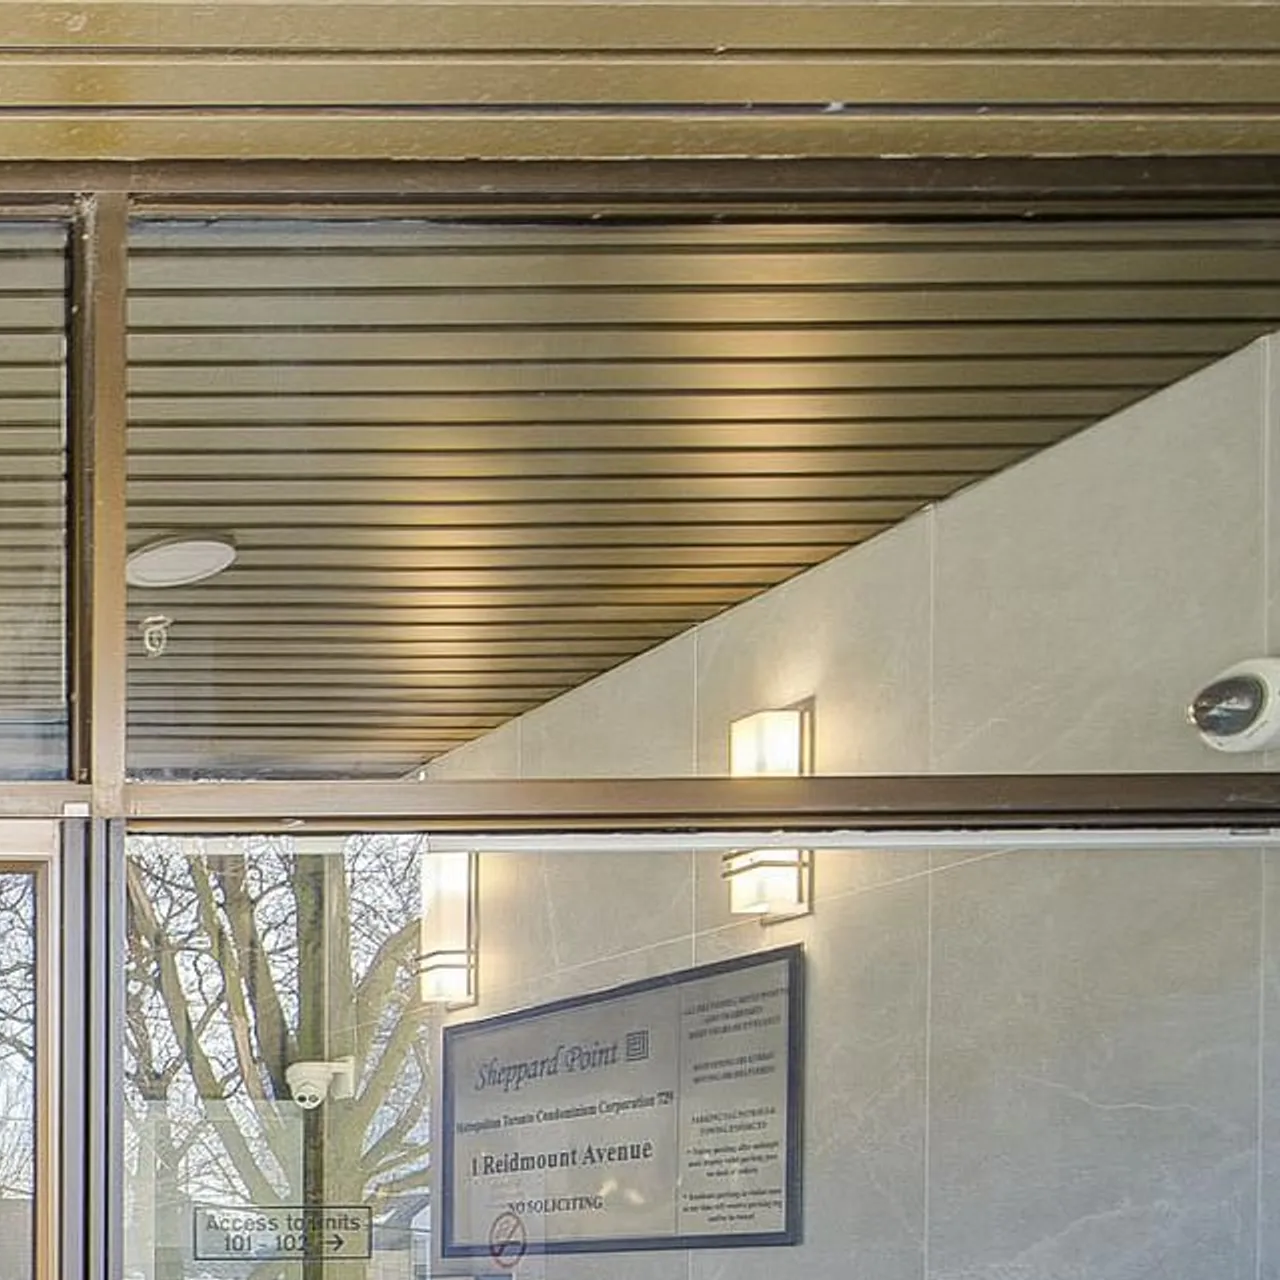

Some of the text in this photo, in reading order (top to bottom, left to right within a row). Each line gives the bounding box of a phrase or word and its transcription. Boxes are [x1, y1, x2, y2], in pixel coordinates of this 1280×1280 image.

[475, 1041, 619, 1093] Sheppard Point
[598, 1097, 655, 1115] Corporation
[472, 1141, 654, 1177] 1 Reidmount Avenue
[527, 1196, 603, 1214] SOLICITING
[205, 1213, 280, 1232] Access
[286, 1212, 306, 1232] to
[224, 1234, 252, 1251] 101
[275, 1234, 309, 1251] 102
